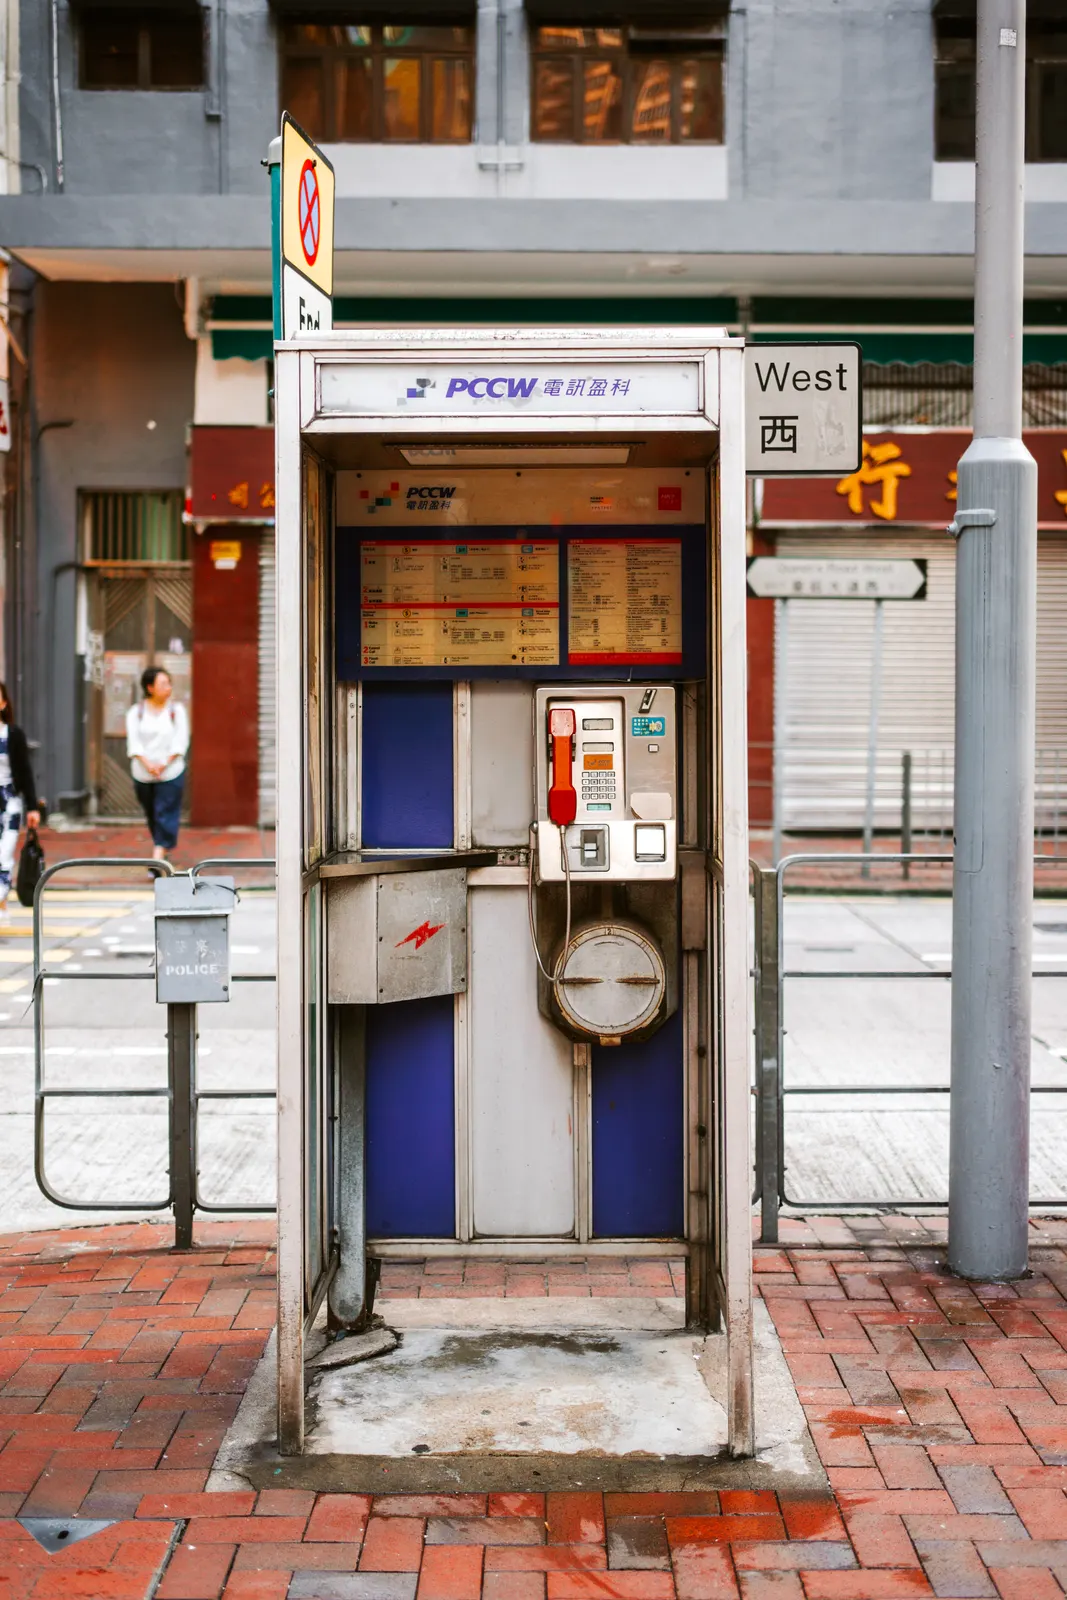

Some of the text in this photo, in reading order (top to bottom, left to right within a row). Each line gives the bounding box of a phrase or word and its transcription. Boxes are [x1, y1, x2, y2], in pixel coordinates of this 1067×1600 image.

[755, 362, 847, 391] West
[446, 377, 631, 398] PCCW 電訊盈科
[759, 415, 798, 453] 西
[406, 487, 456, 498] PCCW
[406, 500, 451, 510] 電訊盈科
[165, 964, 219, 976] POLICE
